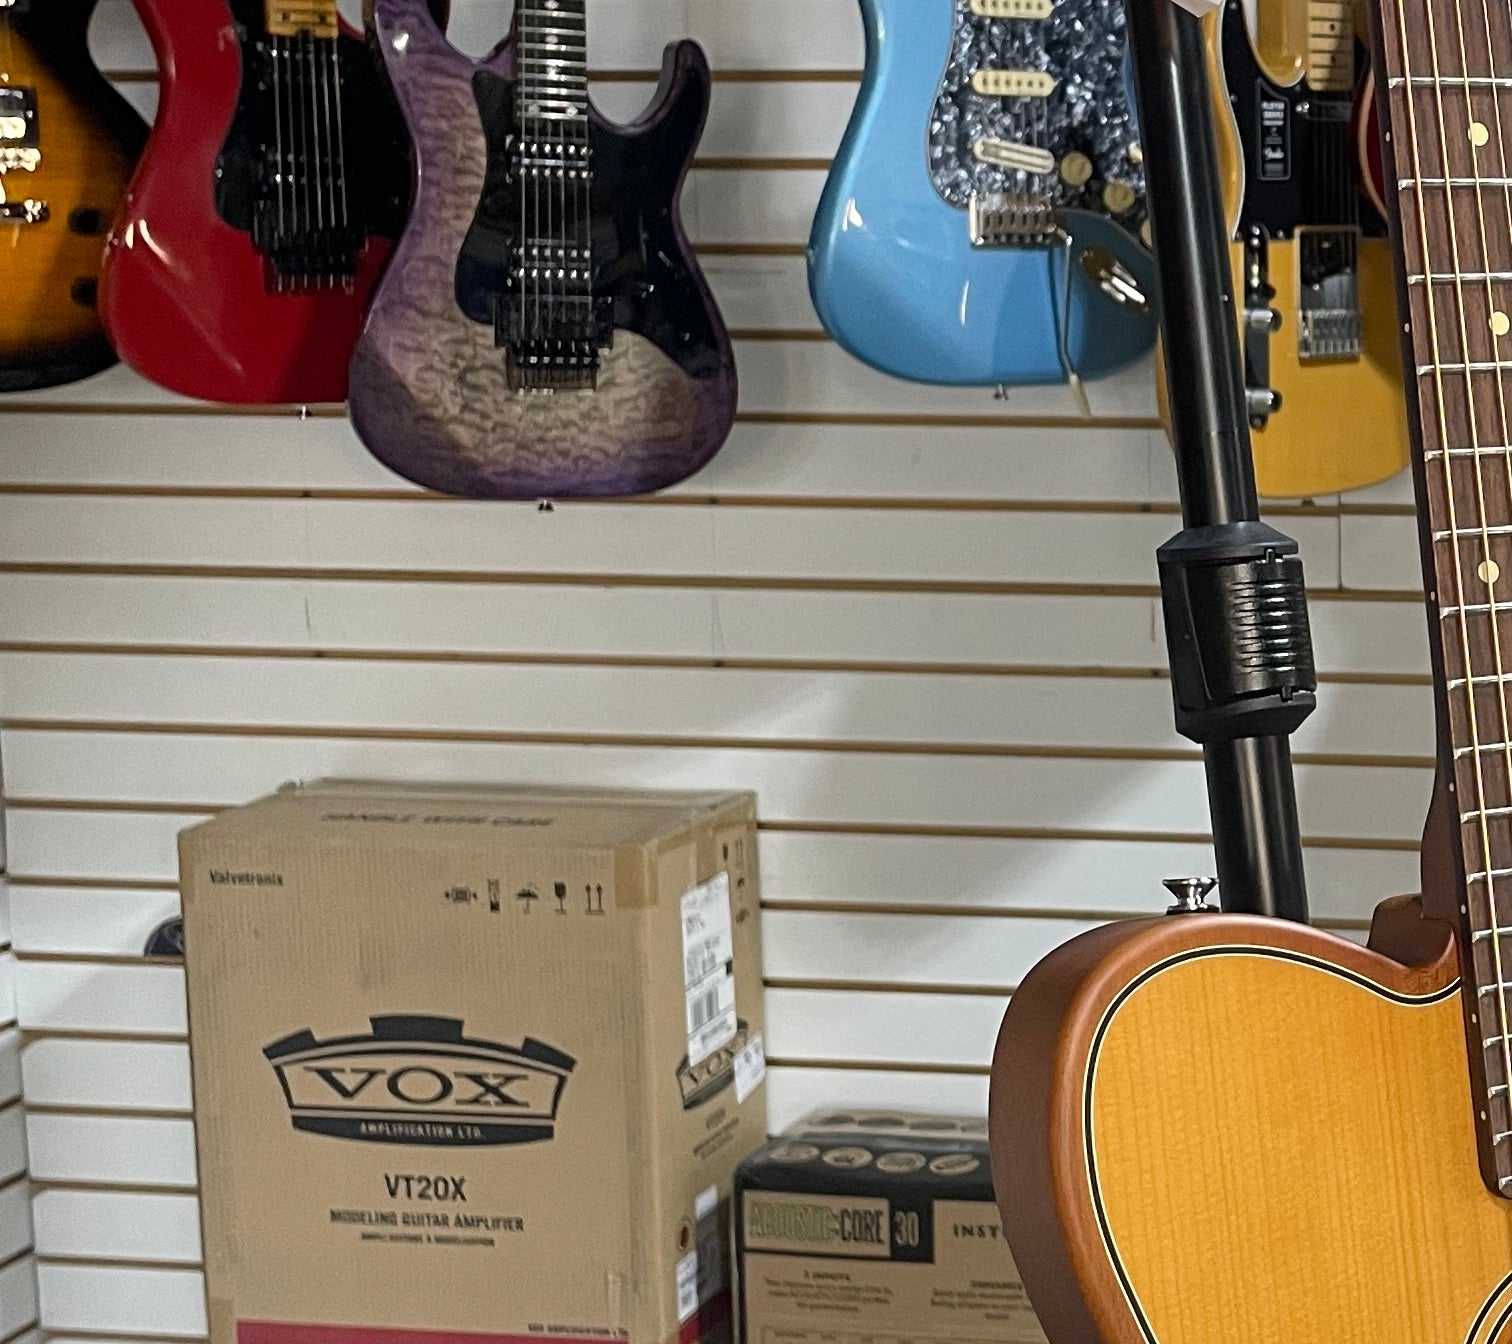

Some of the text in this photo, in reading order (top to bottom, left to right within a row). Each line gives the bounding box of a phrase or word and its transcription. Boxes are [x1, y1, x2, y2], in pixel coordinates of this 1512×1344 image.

[304, 1065, 533, 1109] VOX
[384, 1172, 468, 1203] VT20X
[402, 1211, 450, 1229] GUITAR
[454, 1213, 525, 1232] AMPLIFIER
[894, 1210, 920, 1248] 30
